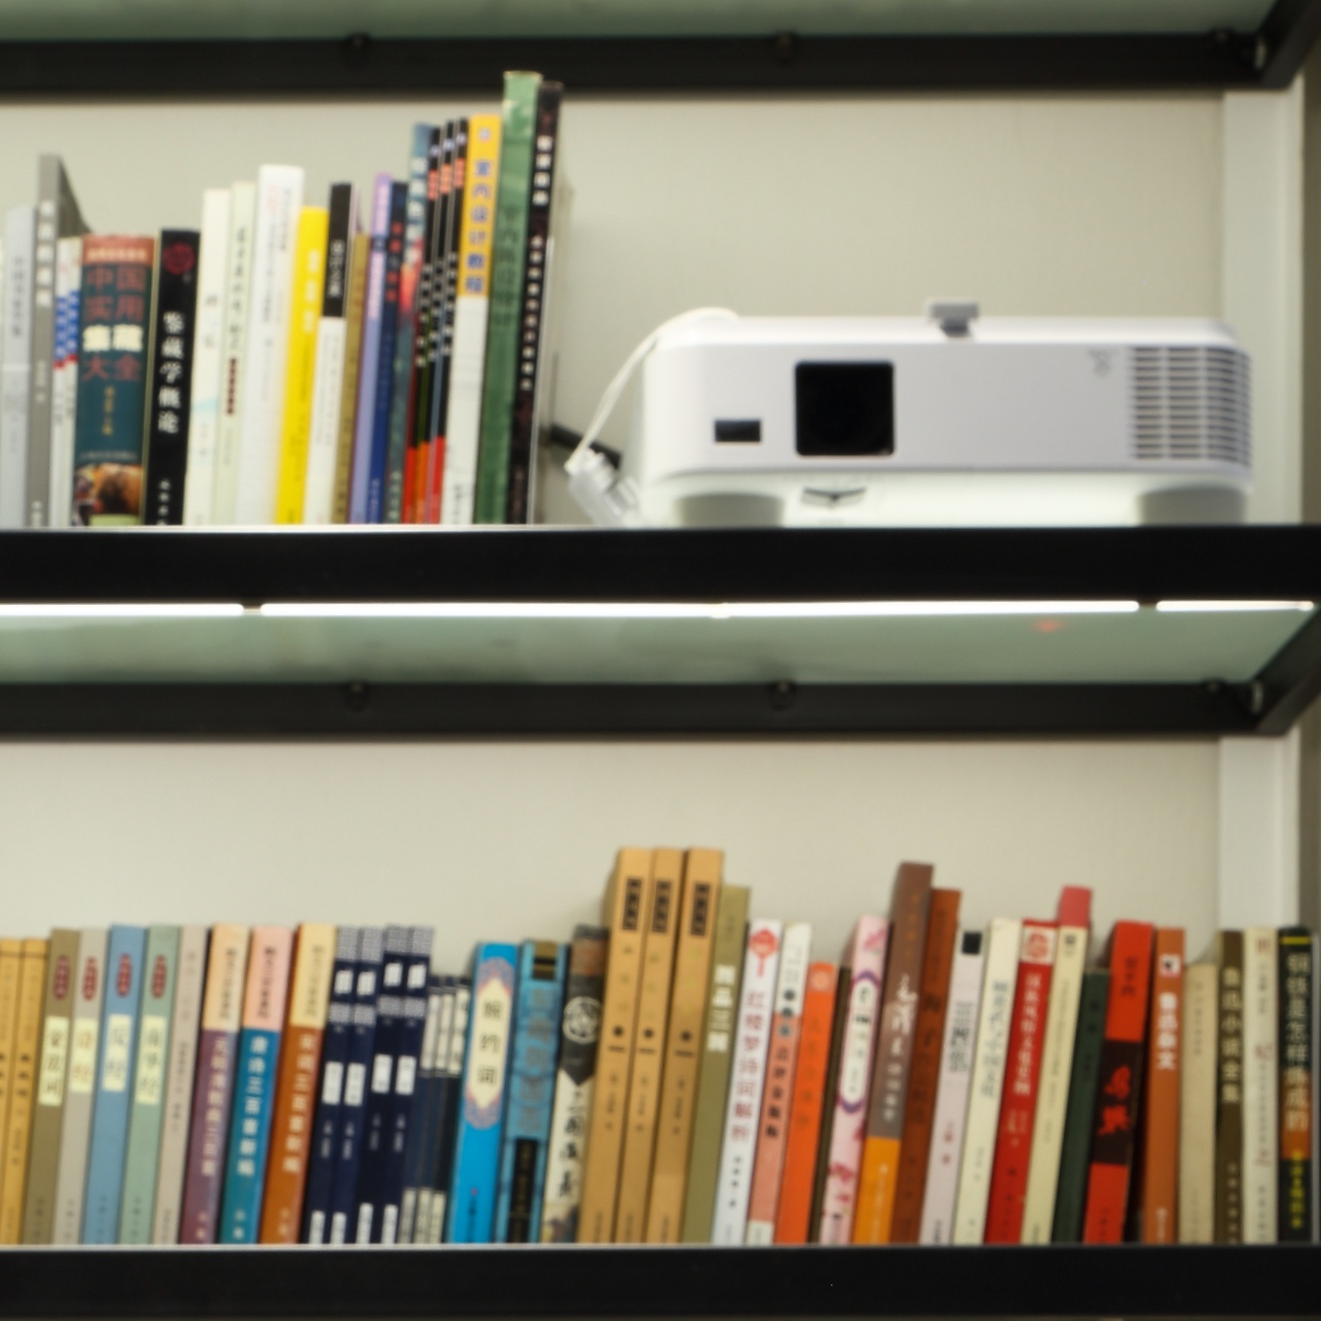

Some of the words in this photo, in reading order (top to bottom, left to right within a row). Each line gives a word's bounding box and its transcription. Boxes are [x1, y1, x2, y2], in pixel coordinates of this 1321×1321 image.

[465, 159, 493, 293] 室内设计教程
[86, 267, 145, 292] 中国
[84, 296, 144, 322] 实用
[82, 356, 141, 382] 大全
[477, 1001, 502, 1085] 婉约词
[1285, 952, 1310, 1132] 钢铁是怎样炼成的
